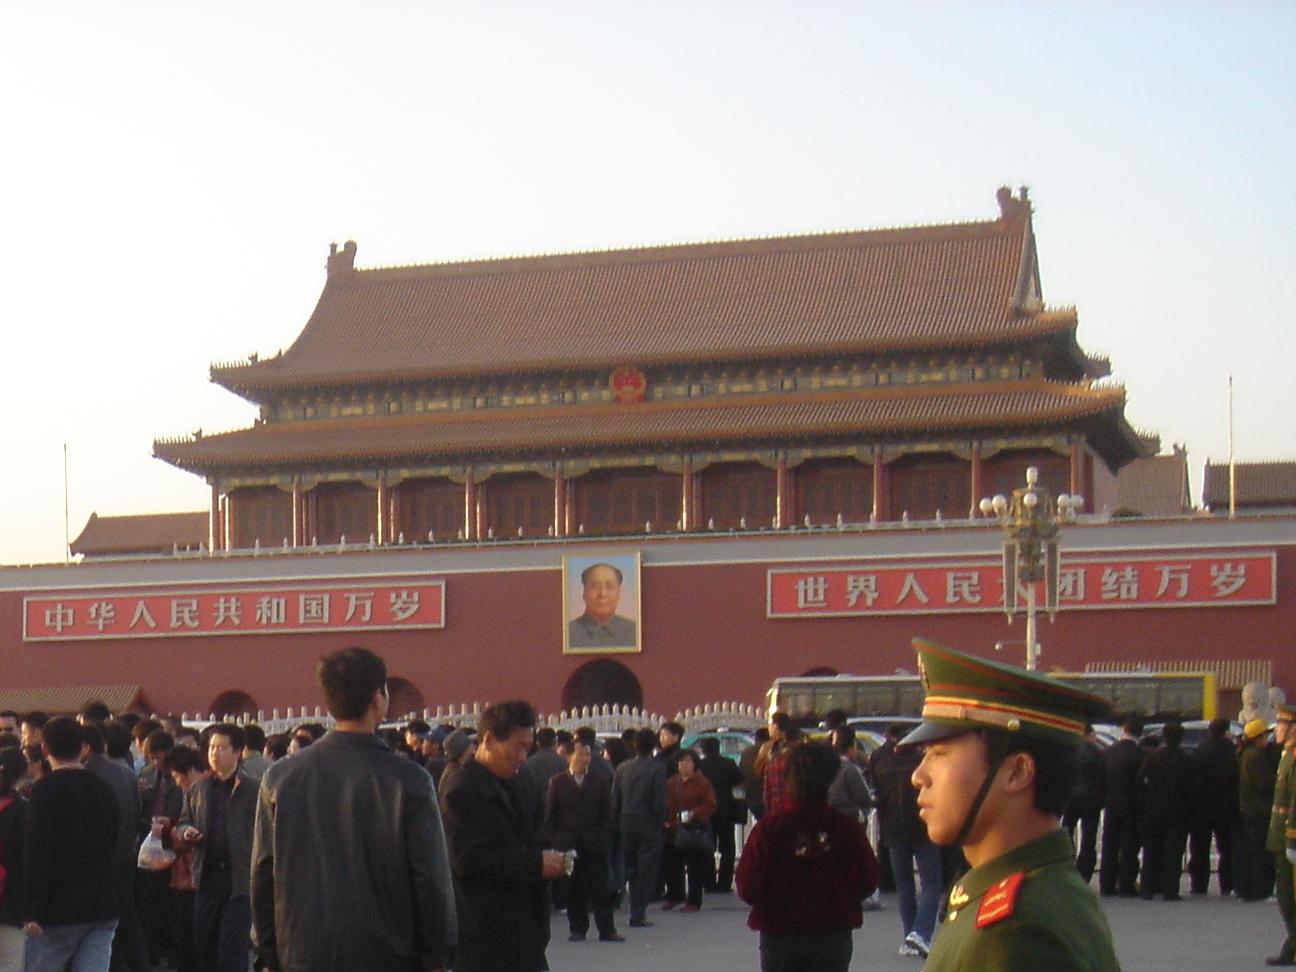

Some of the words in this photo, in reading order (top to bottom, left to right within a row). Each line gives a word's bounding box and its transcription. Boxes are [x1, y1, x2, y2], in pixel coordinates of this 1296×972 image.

[44, 591, 421, 634] 中华人民共和国万岁
